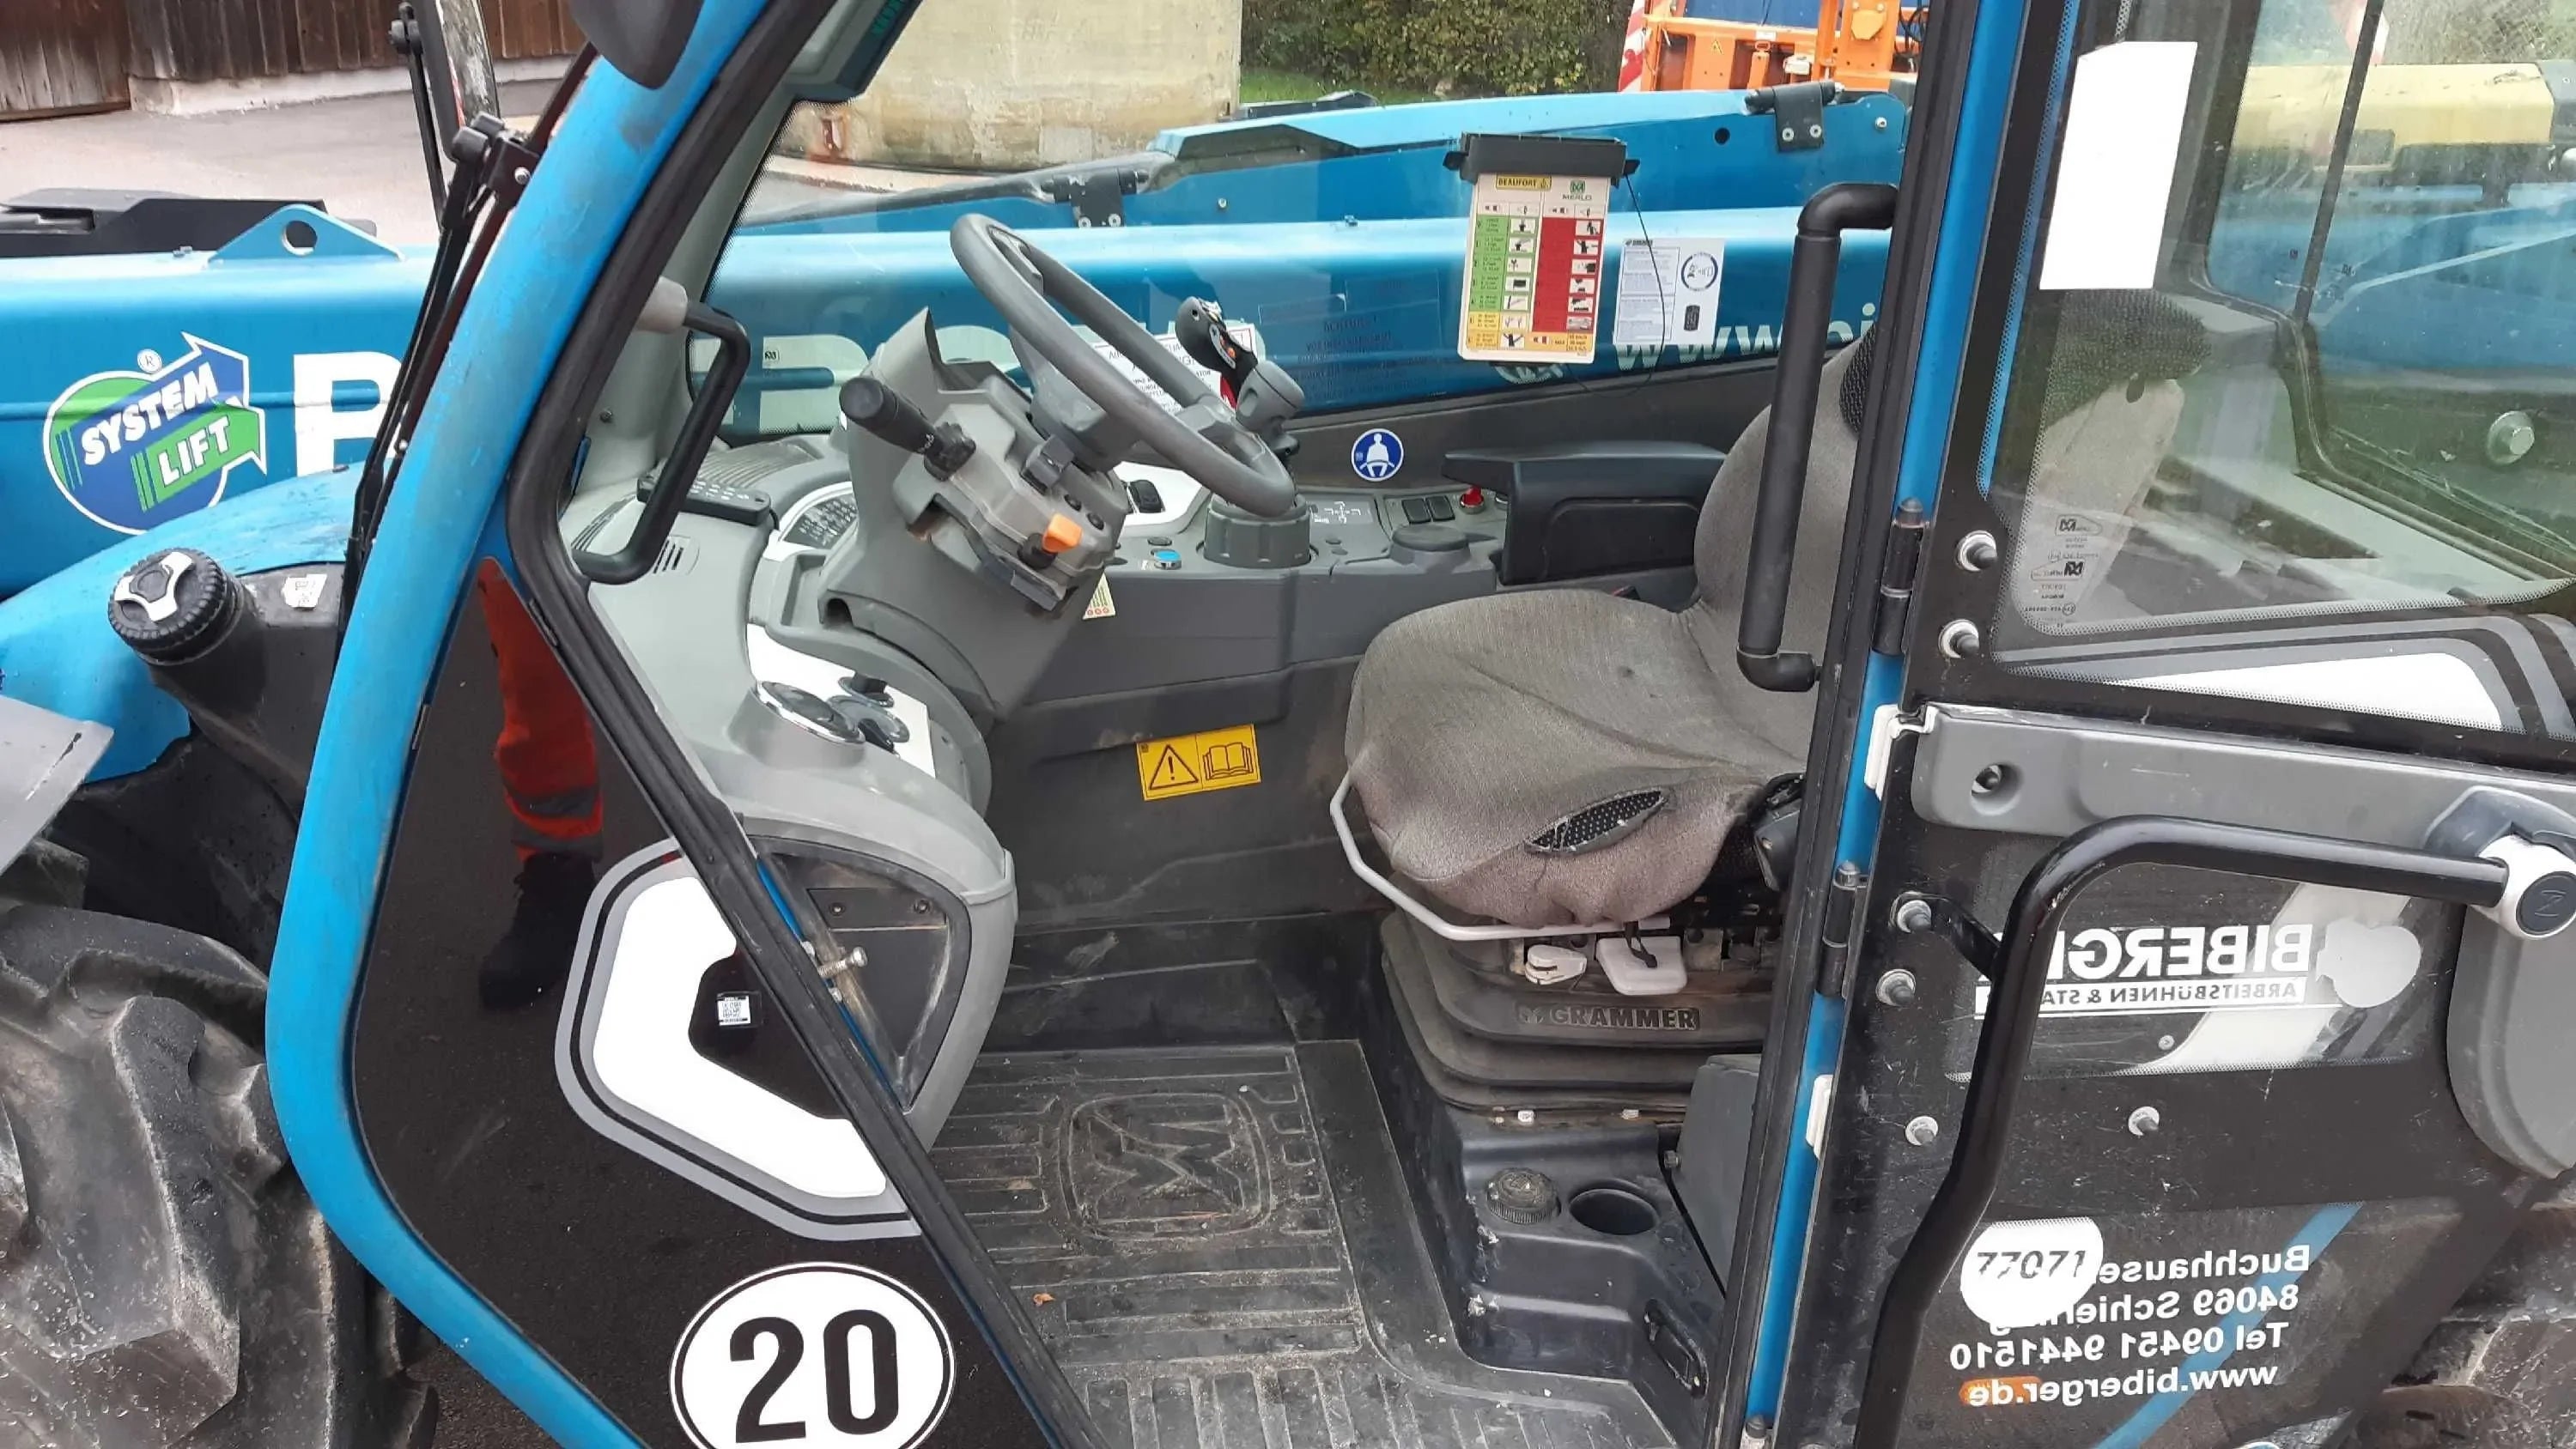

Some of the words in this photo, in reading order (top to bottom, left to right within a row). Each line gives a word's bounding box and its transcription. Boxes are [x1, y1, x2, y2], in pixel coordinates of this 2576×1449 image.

[1498, 177, 1537, 186] BEAUFORT
[82, 361, 218, 465] SYSTEM
[159, 415, 230, 488] LIFT
[1550, 1007, 1698, 1031] GRAMMER
[729, 1308, 900, 1444] 20
